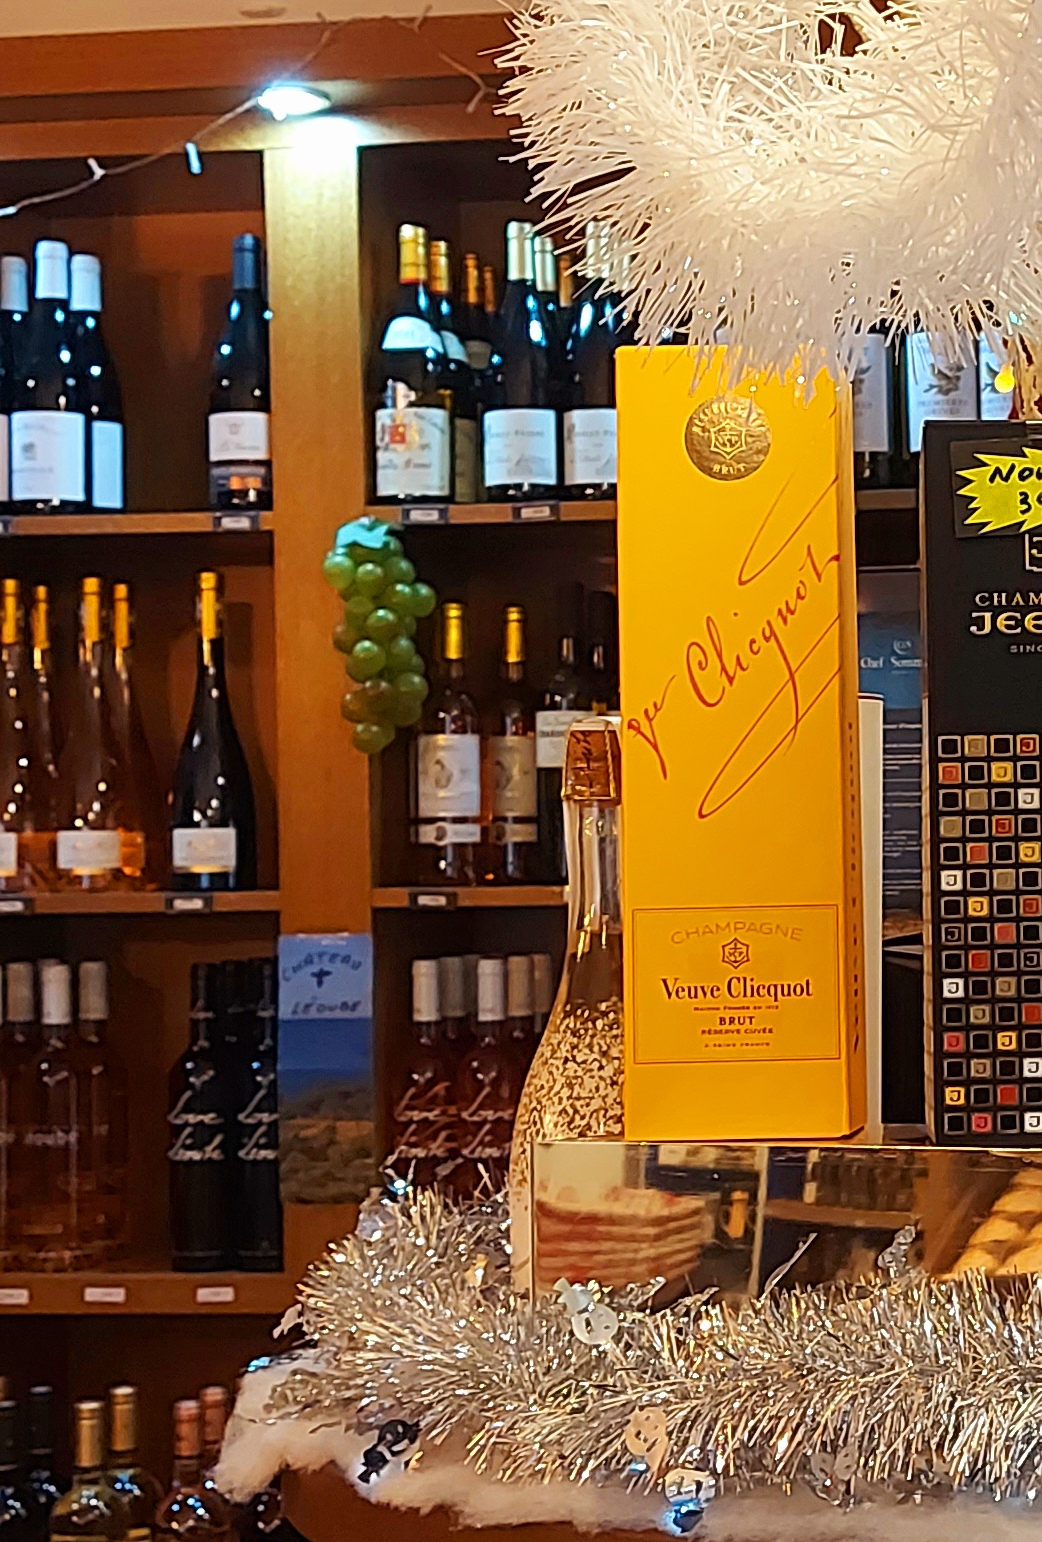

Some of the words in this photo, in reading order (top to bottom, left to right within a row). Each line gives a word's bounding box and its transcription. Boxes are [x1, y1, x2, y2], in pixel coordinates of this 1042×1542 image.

[670, 920, 804, 945] CHAMPAGNE
[660, 976, 721, 1000] Veuve
[725, 975, 814, 1003] Clicquot
[718, 1015, 756, 1026] BRUT
